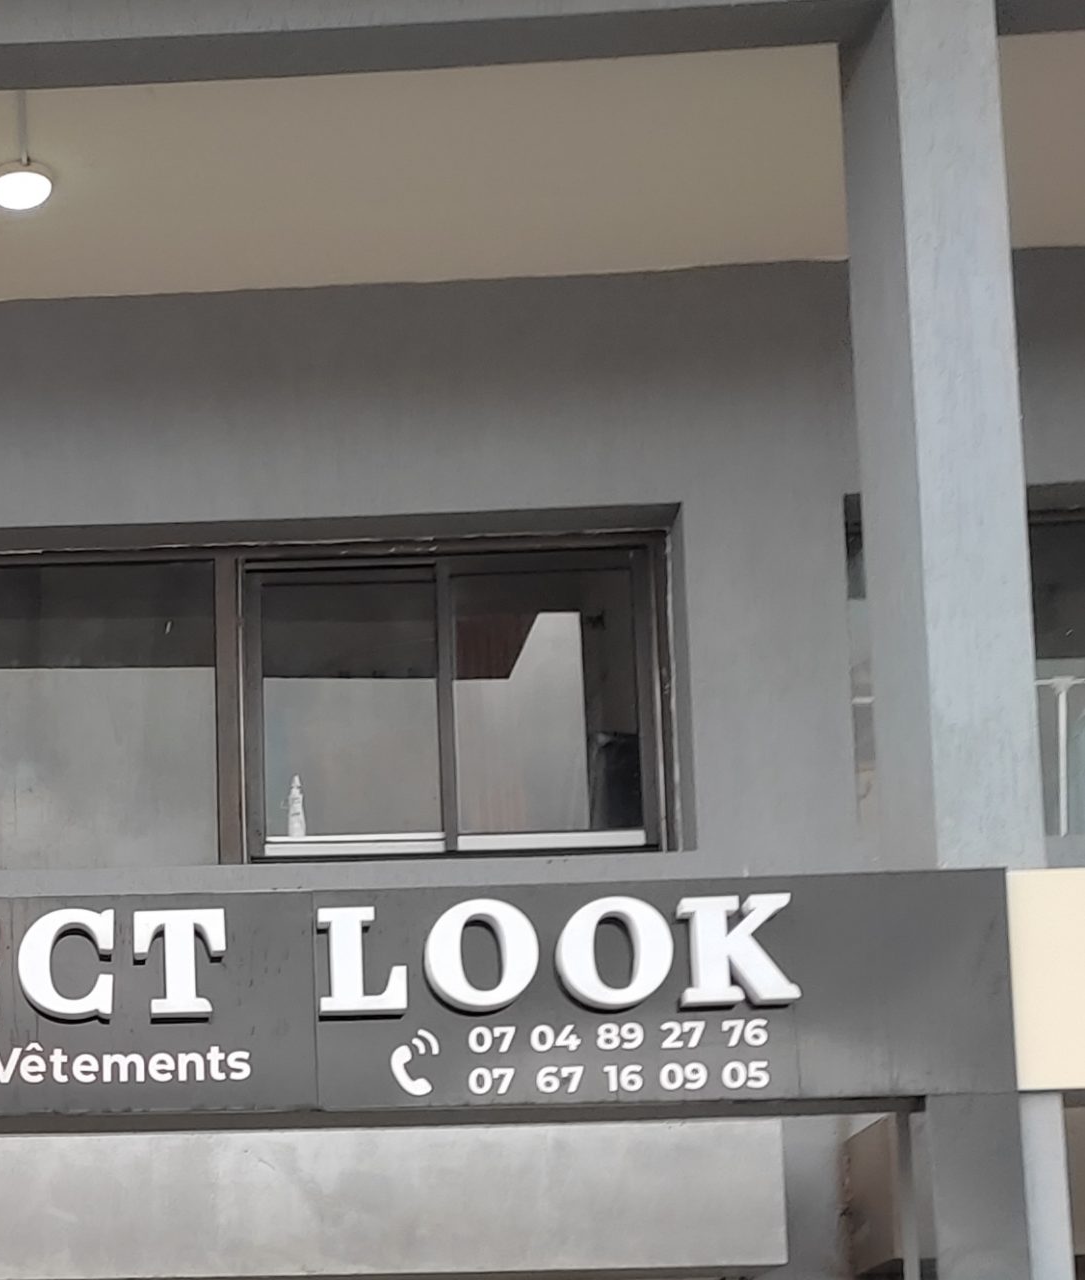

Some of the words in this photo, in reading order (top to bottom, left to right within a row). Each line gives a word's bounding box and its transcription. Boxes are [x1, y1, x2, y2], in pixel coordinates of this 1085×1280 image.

[317, 892, 803, 1016] LOOK
[468, 1026, 516, 1053] 07
[530, 1024, 581, 1051] 04
[596, 1022, 644, 1050] 89
[659, 1020, 706, 1049] 27
[721, 1018, 768, 1047] 76
[468, 1067, 515, 1094] 07
[536, 1065, 584, 1093] 67
[603, 1064, 643, 1092] 16
[659, 1062, 708, 1090] 09
[721, 1060, 770, 1089] 05
